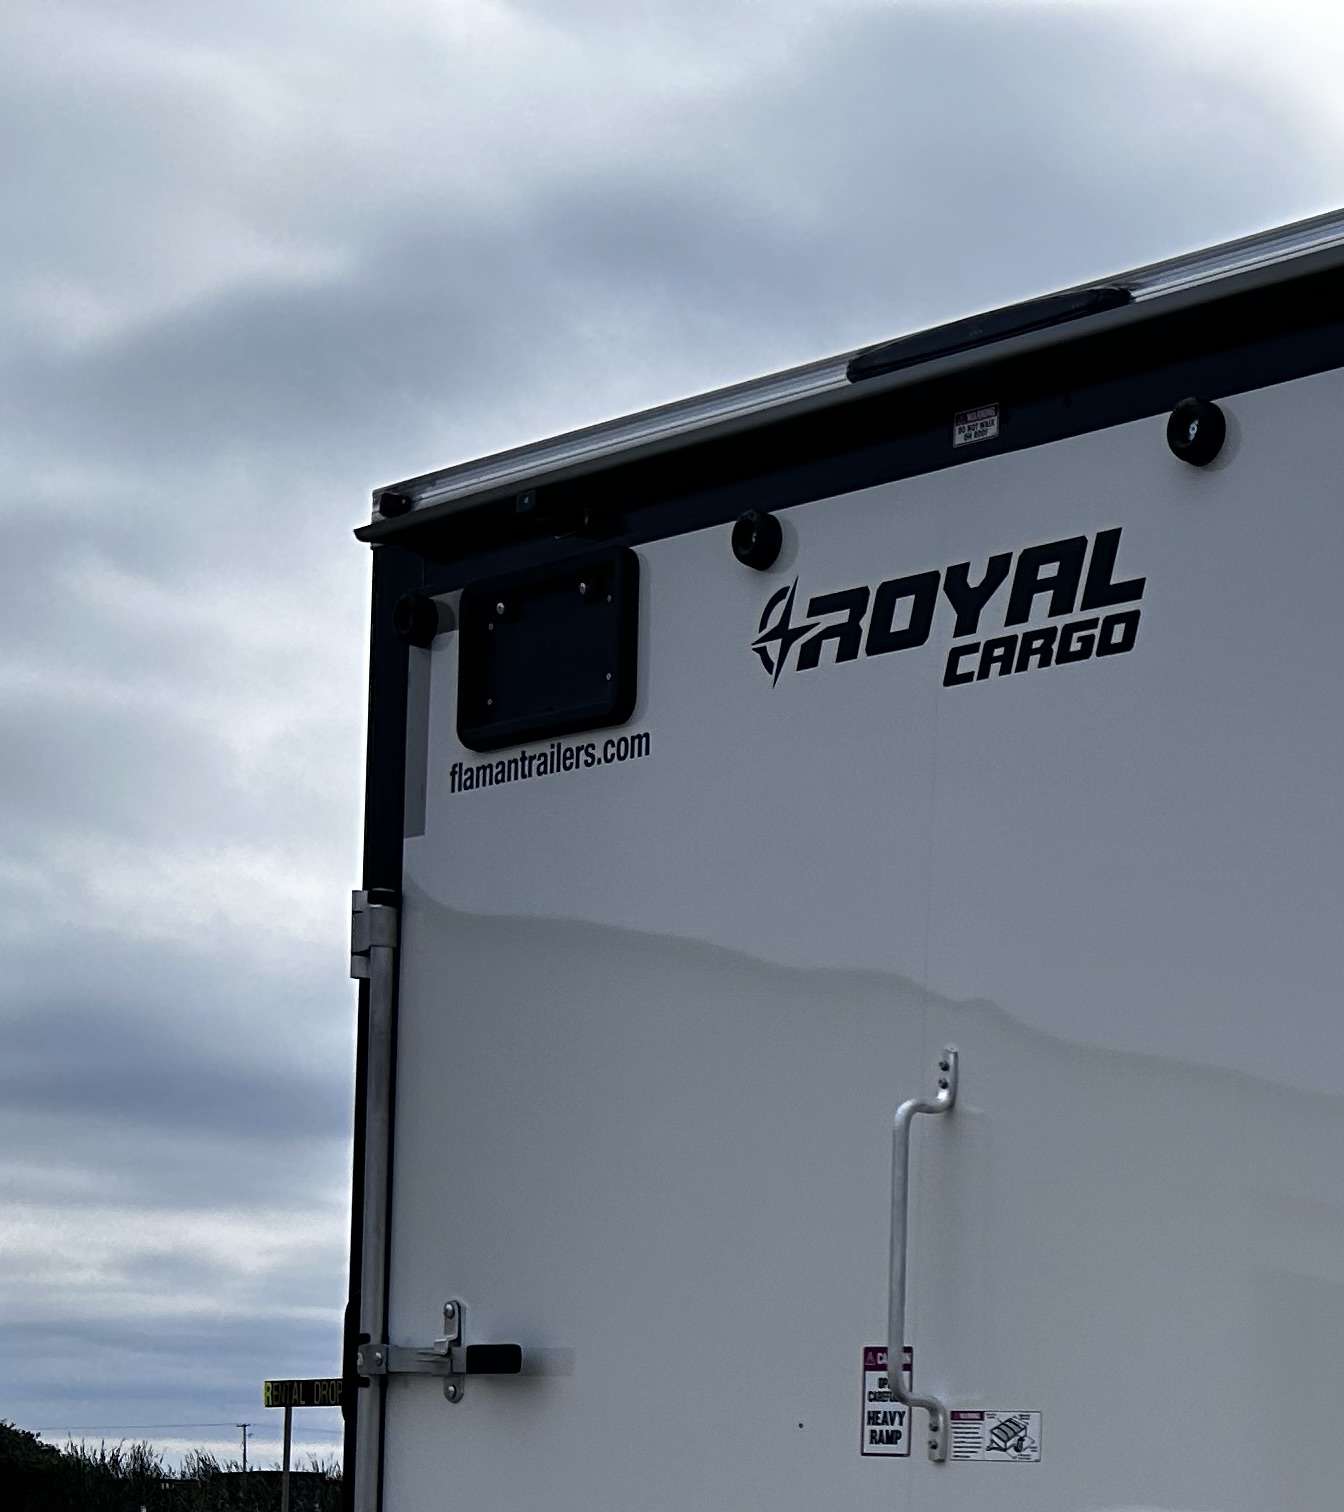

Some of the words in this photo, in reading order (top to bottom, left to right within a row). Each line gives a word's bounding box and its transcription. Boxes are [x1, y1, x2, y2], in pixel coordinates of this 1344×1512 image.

[796, 526, 1147, 672] ROYAL
[942, 609, 1141, 687] CARGO
[450, 732, 650, 793] flamantrailers.com
[265, 1381, 305, 1406] RENTAL
[866, 1410, 906, 1427] HEAVY
[869, 1429, 902, 1445] RAMP
